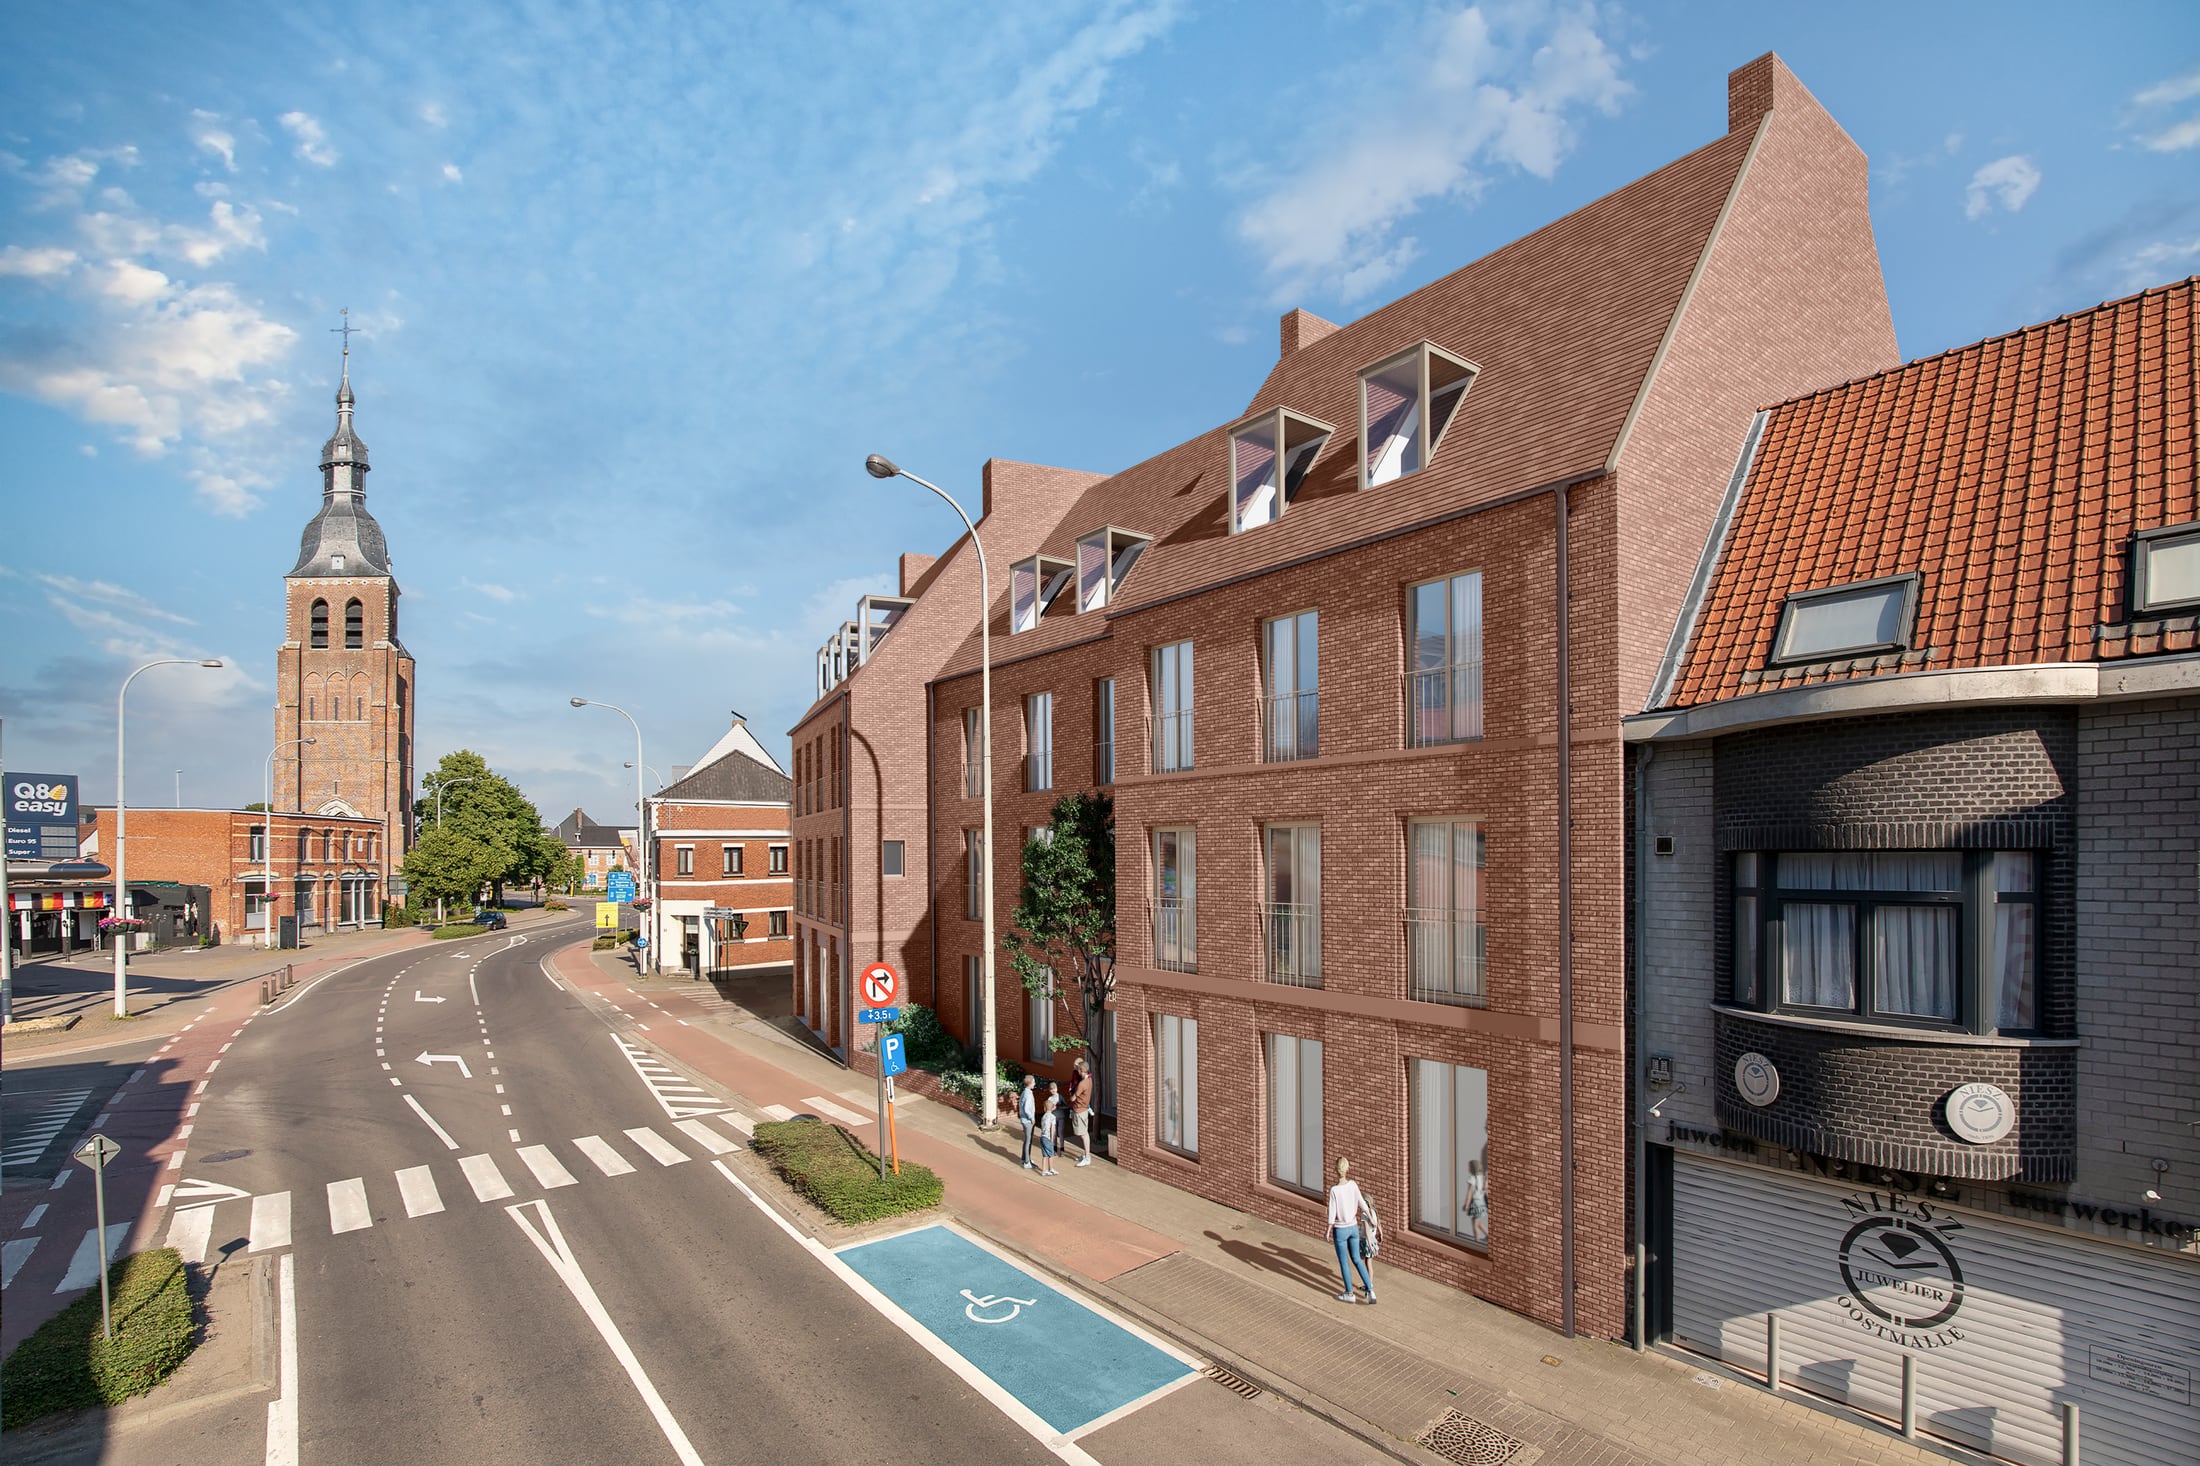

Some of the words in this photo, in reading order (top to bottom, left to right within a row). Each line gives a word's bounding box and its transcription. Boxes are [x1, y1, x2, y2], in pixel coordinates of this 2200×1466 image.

[14, 782, 49, 799] Q8
[14, 800, 67, 816] easy
[886, 1038, 899, 1060] P
[1960, 1085, 2003, 1100] NIESZ
[1666, 1120, 1756, 1155] juwelen
[1840, 1191, 1965, 1241] NIESZ
[1856, 1270, 1945, 1303] JUWELIER
[1837, 1296, 1965, 1349] OOSTMALLE
